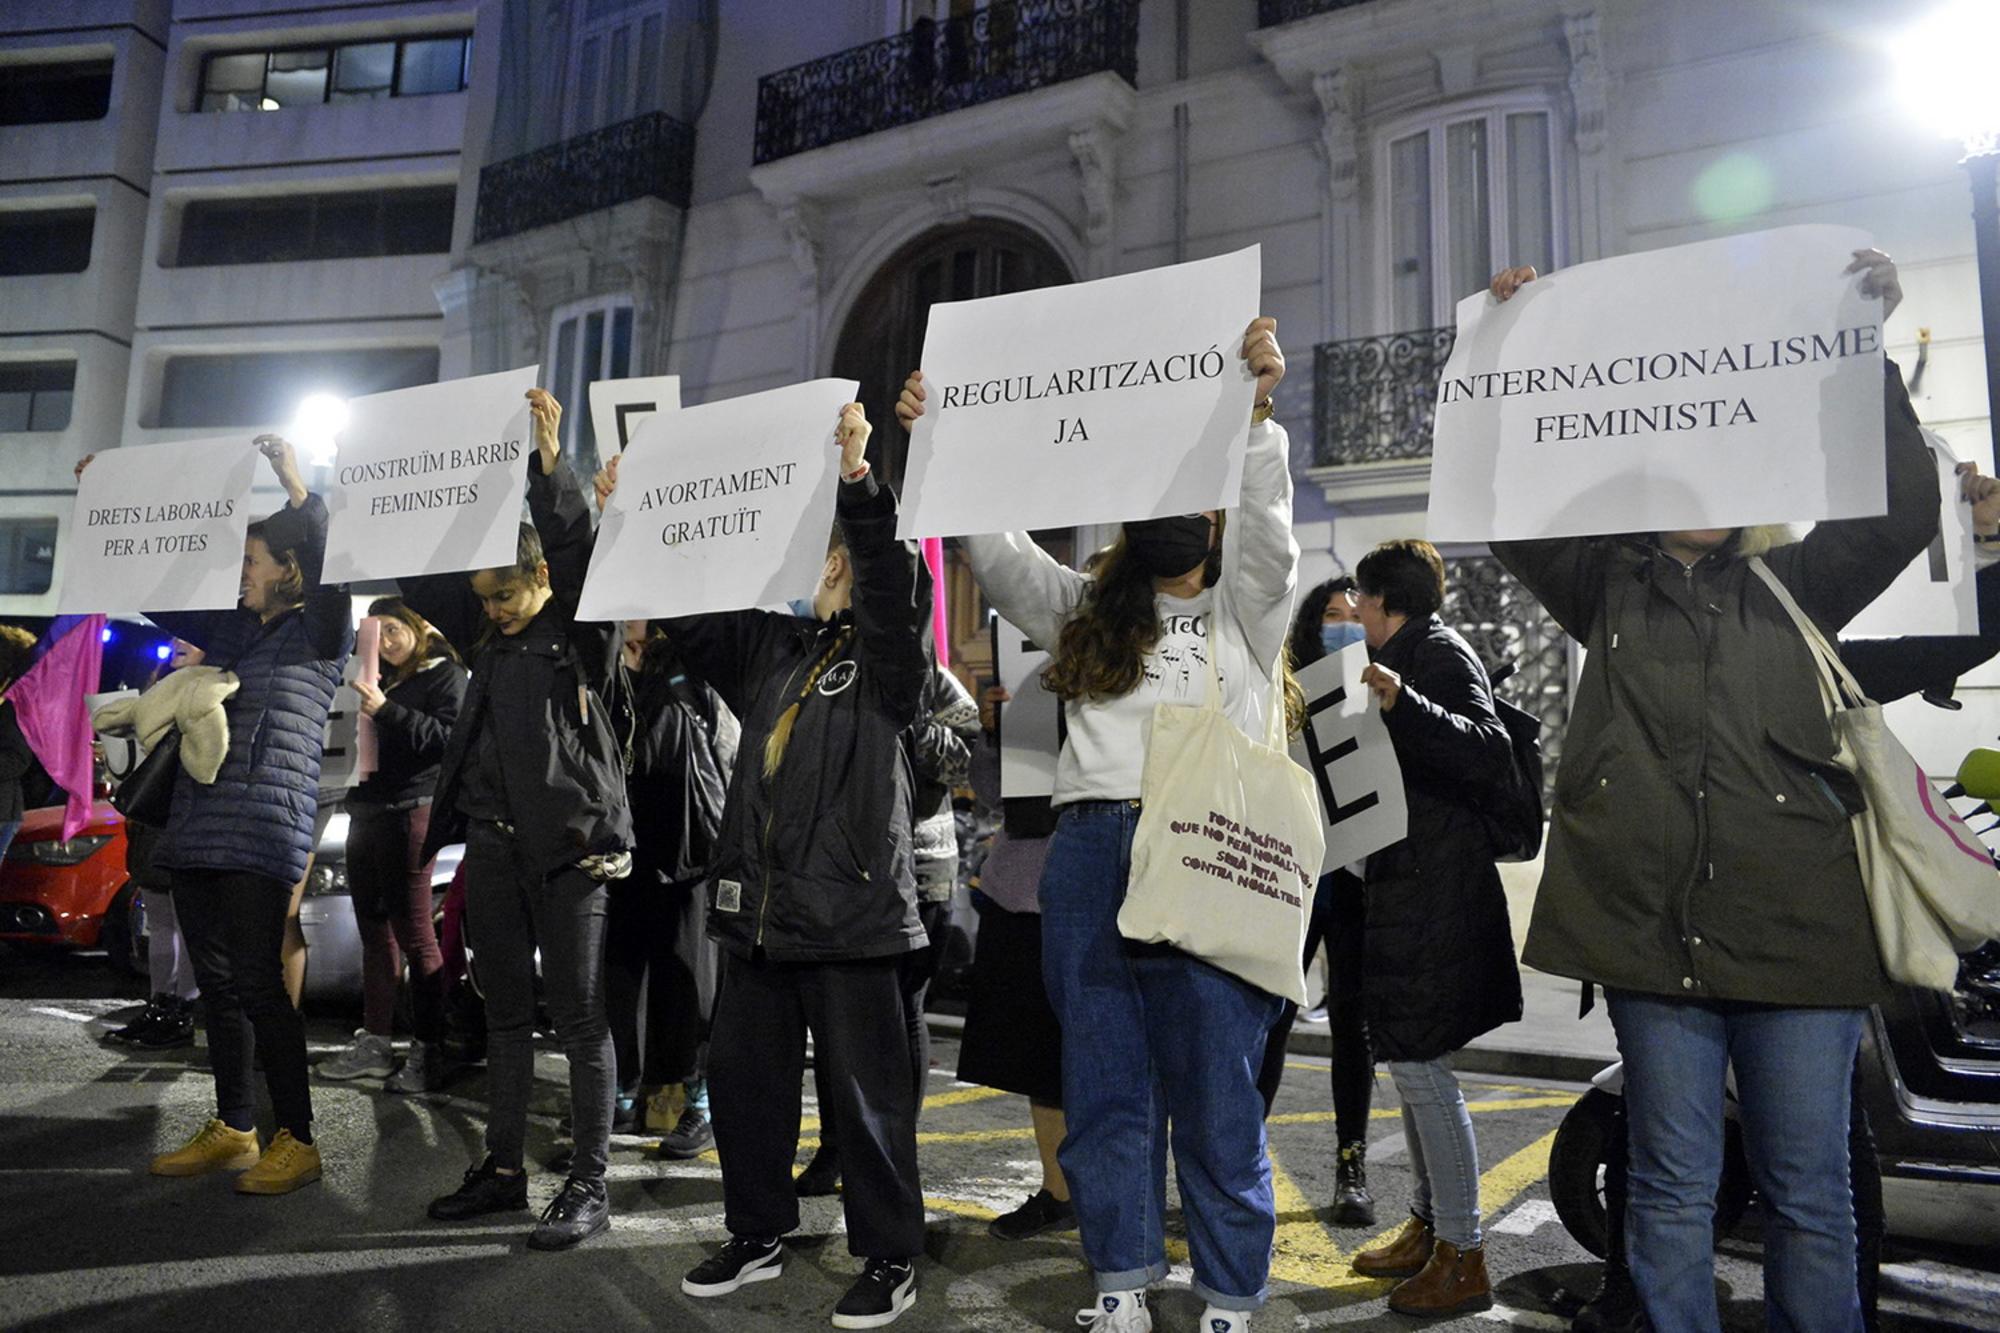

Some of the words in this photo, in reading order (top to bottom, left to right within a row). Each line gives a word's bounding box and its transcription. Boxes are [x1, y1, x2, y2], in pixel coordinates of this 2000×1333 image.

[941, 344, 1224, 410] REGULARITZACIÓ
[1440, 325, 1879, 404] INTERNACIONALISME
[1053, 416, 1090, 445] JA
[1534, 398, 1758, 443] FEMINISTA
[340, 451, 445, 486] CONSTRUÏM
[450, 440, 520, 469] BARRIS
[370, 484, 479, 516] FEMINISTES
[638, 463, 797, 511] AVORTAMENT
[87, 506, 142, 527] DRETS
[144, 499, 235, 522] LABORALS
[661, 506, 762, 546] GRATUÏT
[103, 538, 135, 557] PER
[137, 538, 151, 555] A
[155, 533, 209, 554] TOTES
[1302, 686, 1379, 826] E
[1170, 820, 1200, 834] QUE
[1203, 825, 1225, 842] NO
[1226, 835, 1252, 855] FEM
[1208, 811, 1241, 834] TOTA
[1181, 855, 1234, 882] CONTRA
